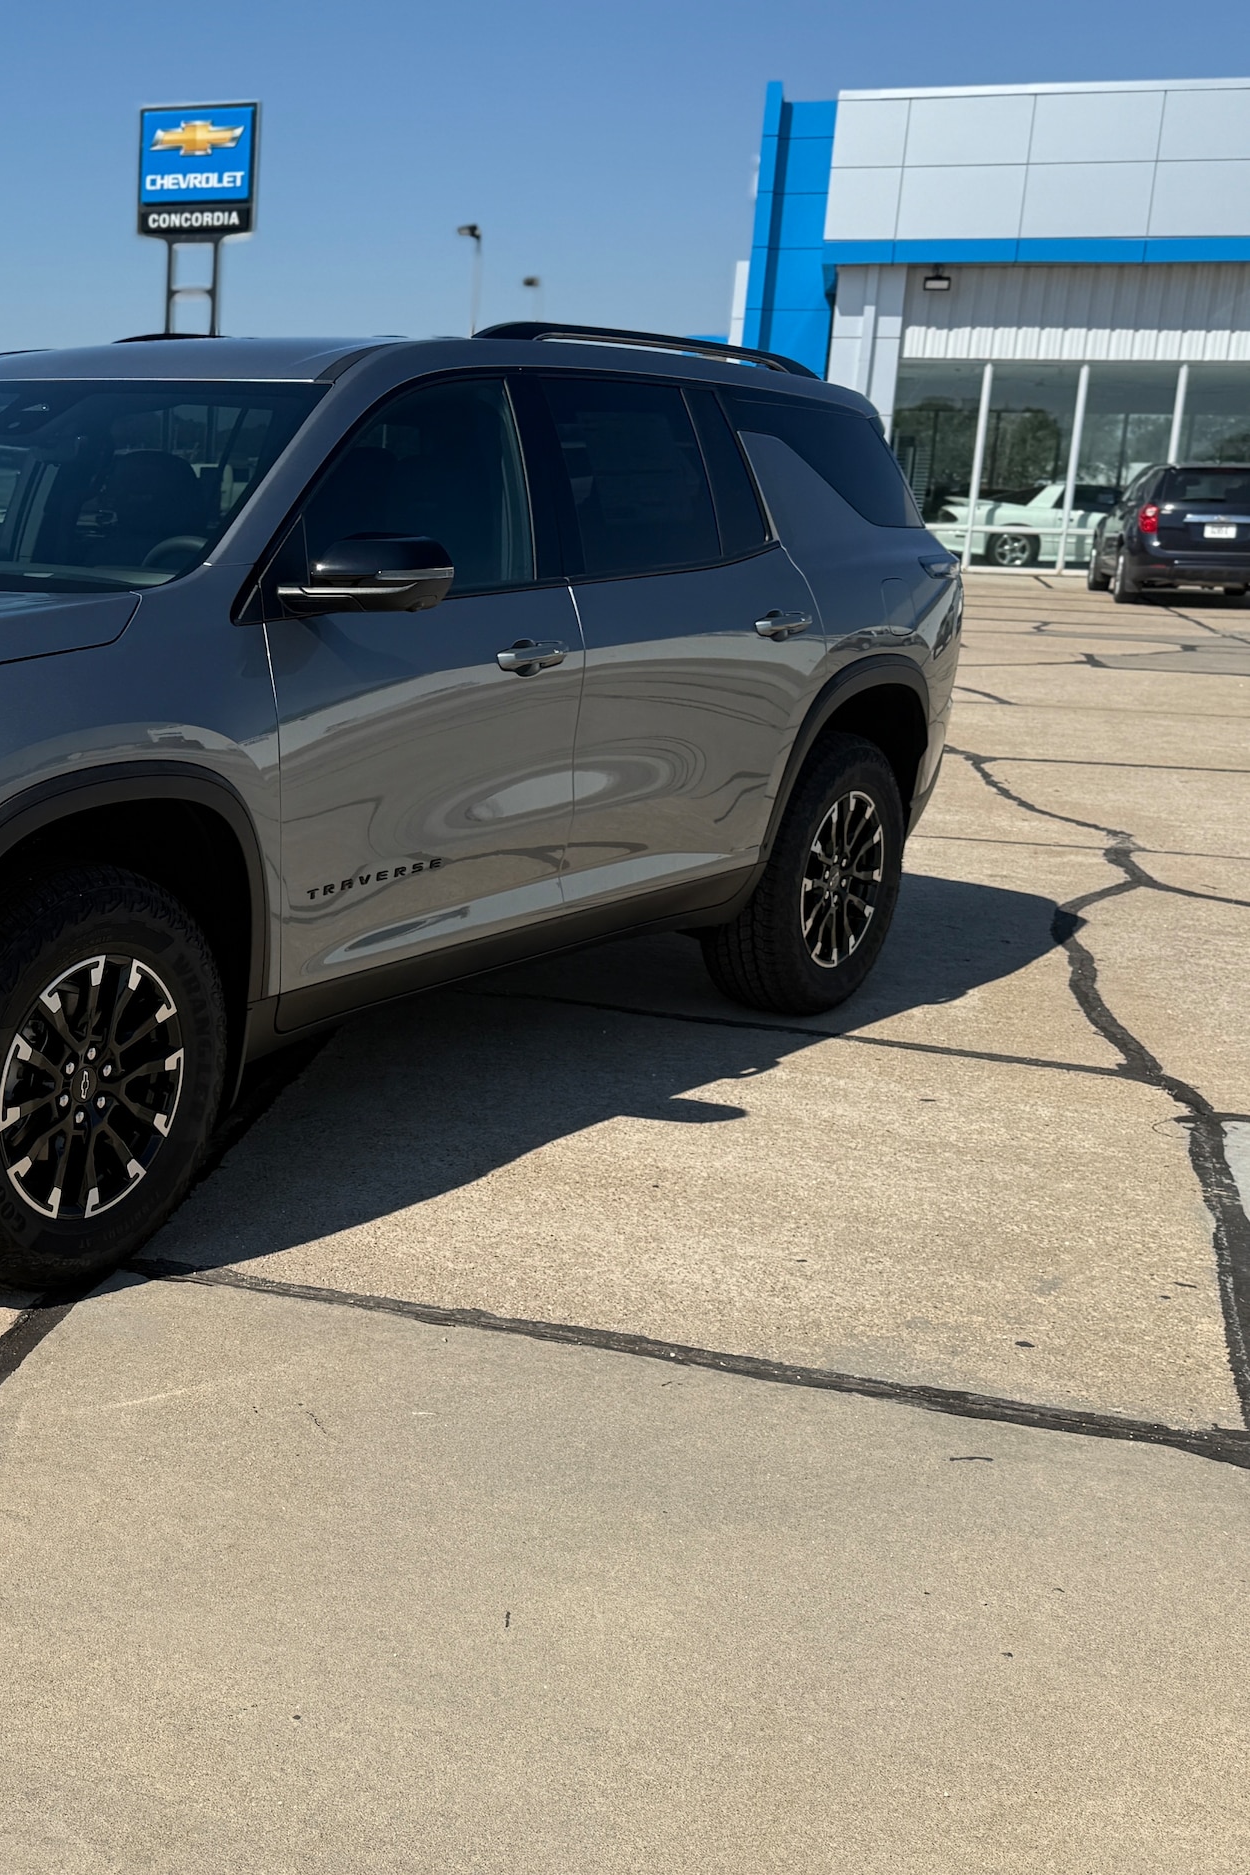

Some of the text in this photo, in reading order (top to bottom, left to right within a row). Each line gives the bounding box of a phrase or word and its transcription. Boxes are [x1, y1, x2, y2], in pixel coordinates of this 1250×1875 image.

[145, 171, 245, 190] CHEVROLET
[148, 211, 239, 228] CONCORDIA
[307, 858, 442, 899] TRAVERSE
